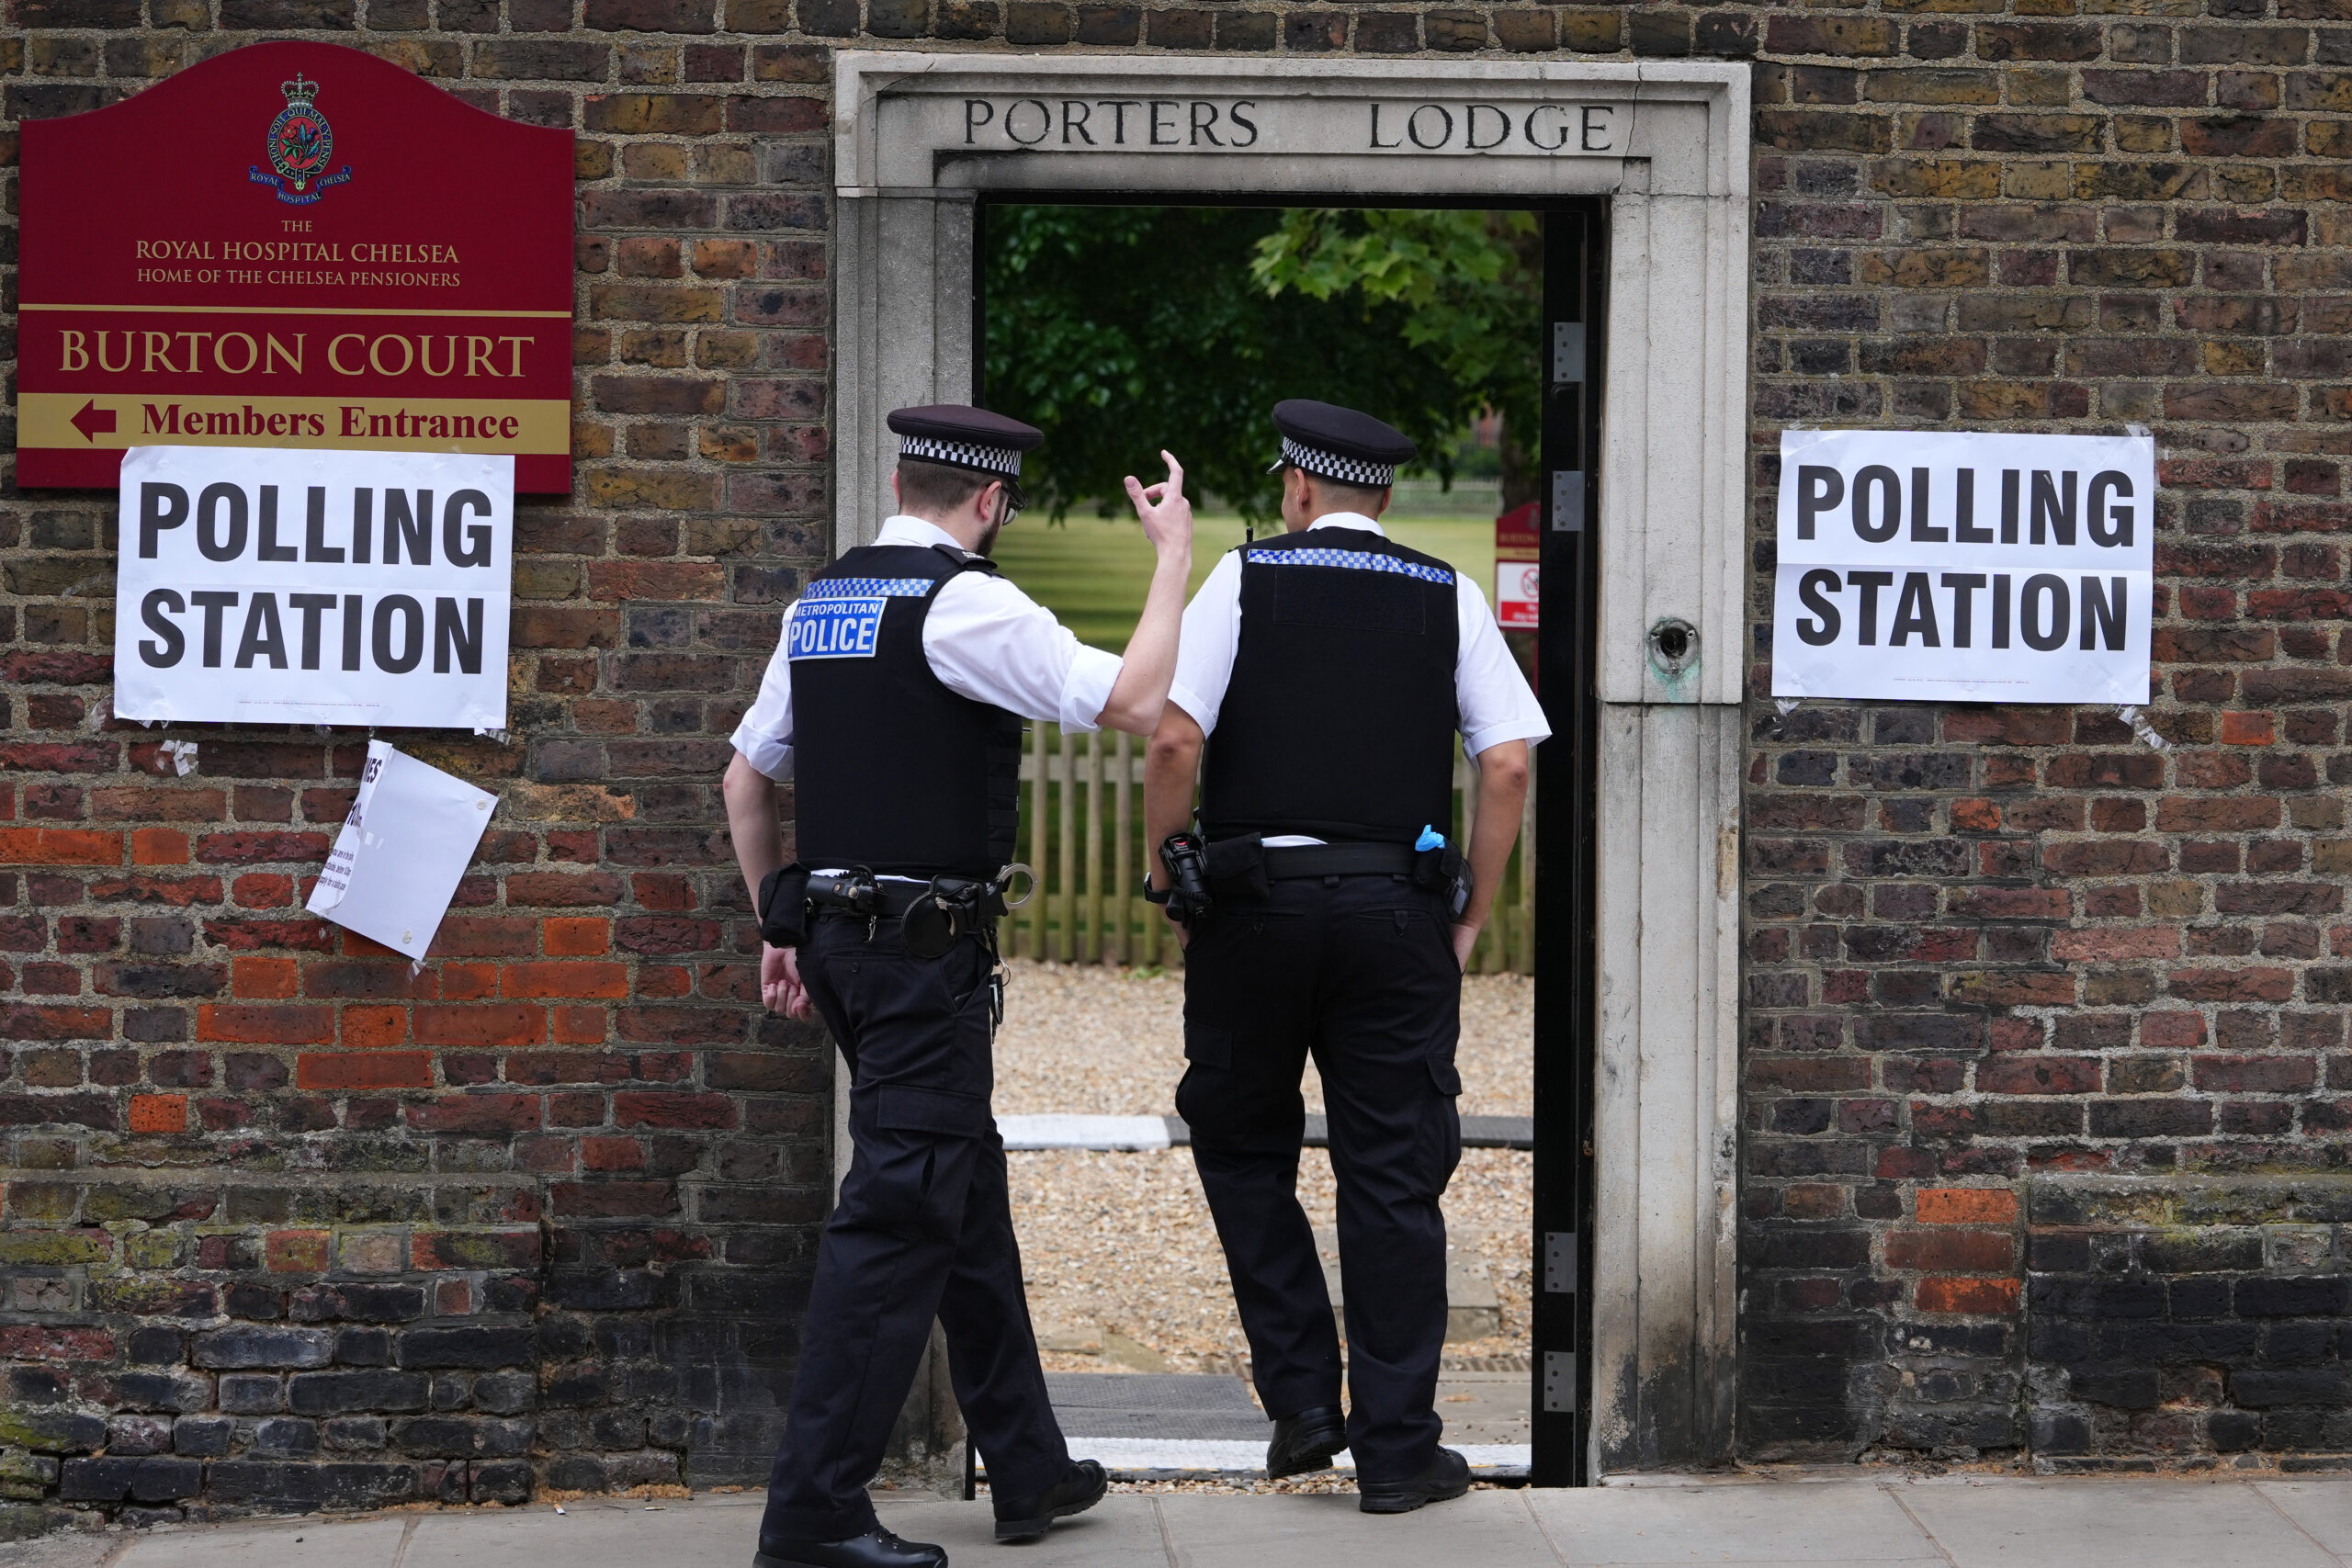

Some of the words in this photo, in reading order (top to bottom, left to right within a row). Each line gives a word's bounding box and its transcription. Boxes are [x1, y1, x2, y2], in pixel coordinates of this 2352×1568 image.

[964, 99, 1259, 147] PORTERS
[1369, 103, 1614, 151] LODGE
[251, 173, 279, 186] ROYAL
[278, 190, 322, 203] HOSPITAL
[319, 173, 351, 186] CHELSEA
[281, 220, 312, 231] THE
[136, 240, 215, 260] ROYAL
[223, 242, 345, 262] HOSPITAL
[351, 243, 460, 264] CHELSEA
[138, 269, 191, 282] HOME
[198, 269, 221, 283] OF
[227, 269, 262, 284] THE
[268, 270, 345, 285] CHELSEA
[351, 272, 460, 287] PENSIONERS
[59, 330, 308, 375] BURTON
[327, 334, 535, 378] COURT
[141, 403, 324, 437] Members
[338, 406, 519, 439] Entrance
[139, 481, 492, 568] POLLING
[1797, 464, 2134, 548] POLLING
[795, 603, 879, 616] METROPOLITAN
[1796, 568, 2127, 651] STATION
[138, 588, 484, 674] STATION
[789, 617, 876, 655] POLICE
